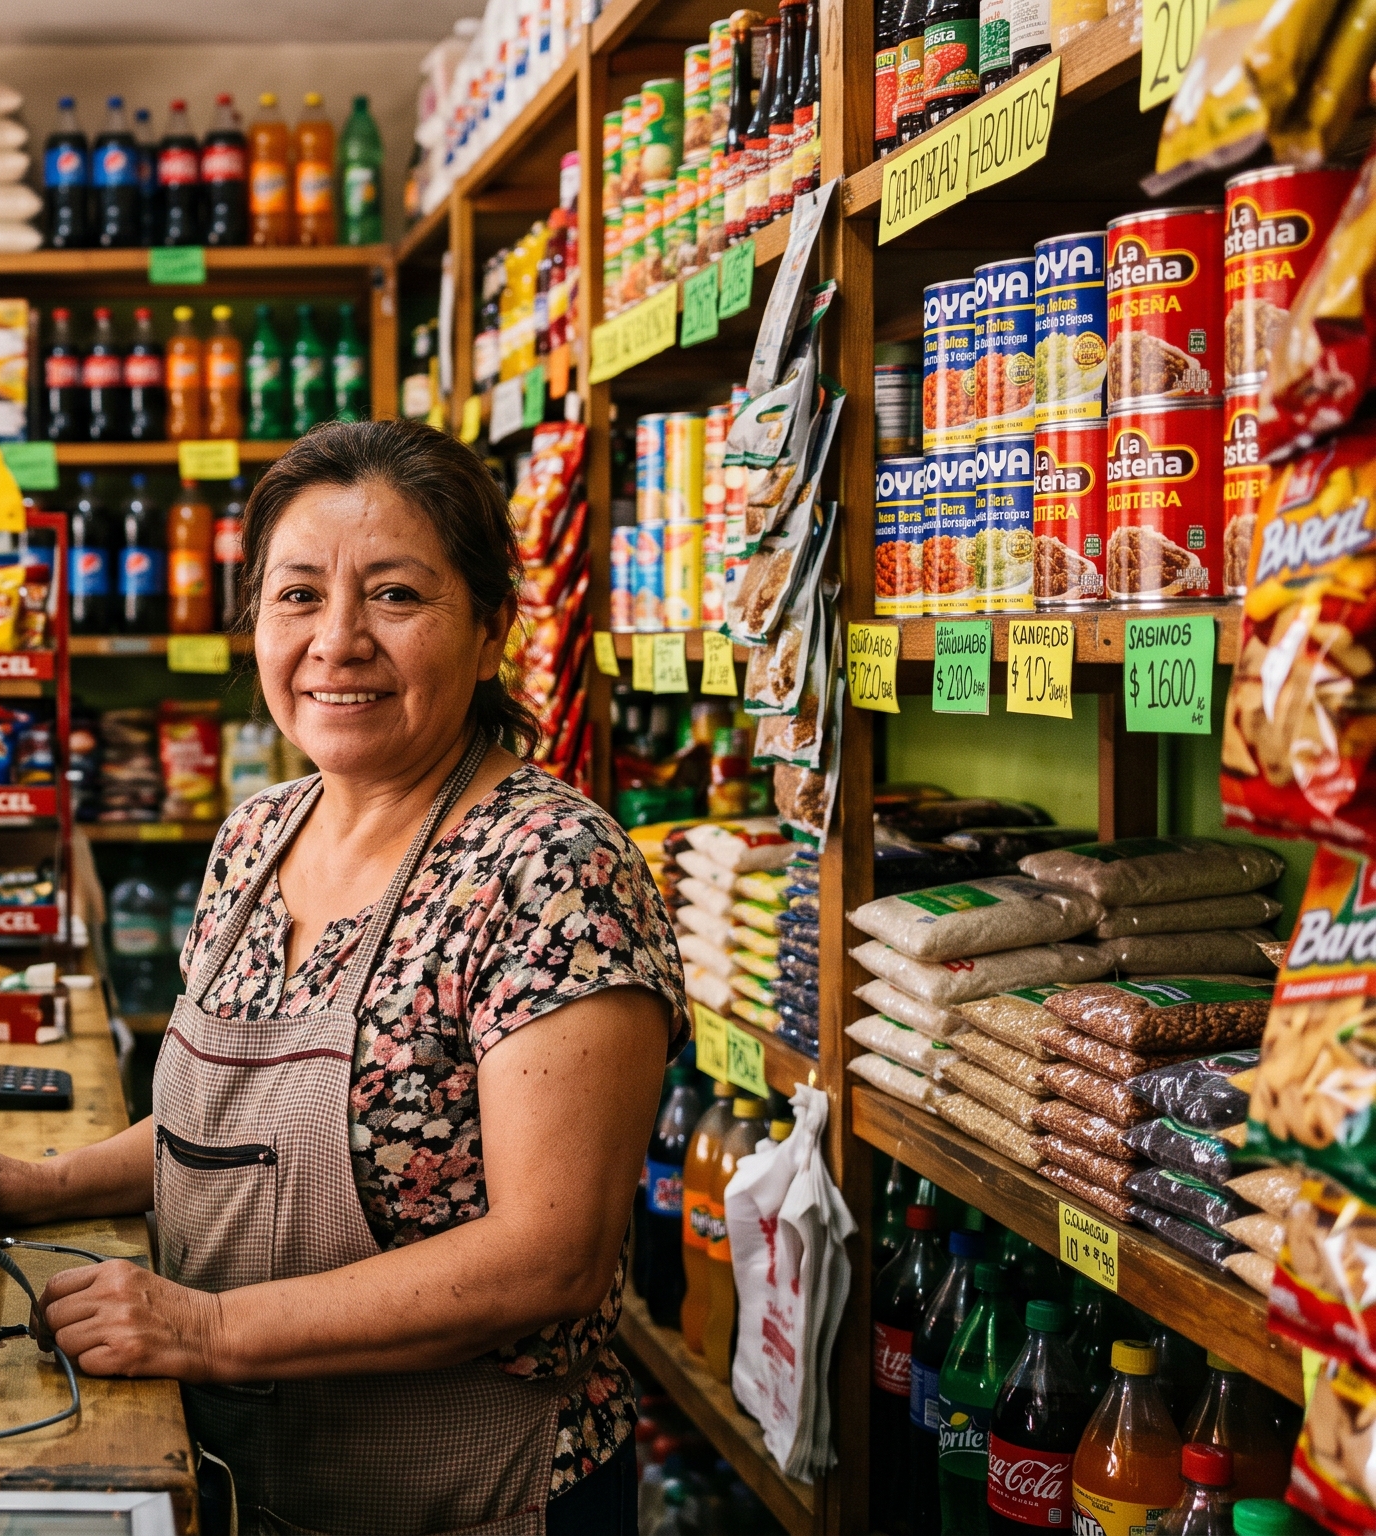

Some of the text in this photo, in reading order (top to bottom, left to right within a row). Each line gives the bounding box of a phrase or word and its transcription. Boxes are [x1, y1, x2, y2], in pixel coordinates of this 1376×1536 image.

[1150, 0, 1211, 92] 20
[1231, 207, 1251, 228] La
[1118, 244, 1138, 264] La
[1234, 418, 1257, 439] La
[1120, 437, 1140, 455] La
[1225, 441, 1258, 467] ste
[1256, 496, 1371, 582] BARCEL
[937, 665, 944, 697] $
[1130, 657, 1196, 709] $ 1600
[939, 1424, 983, 1451] Sprite
